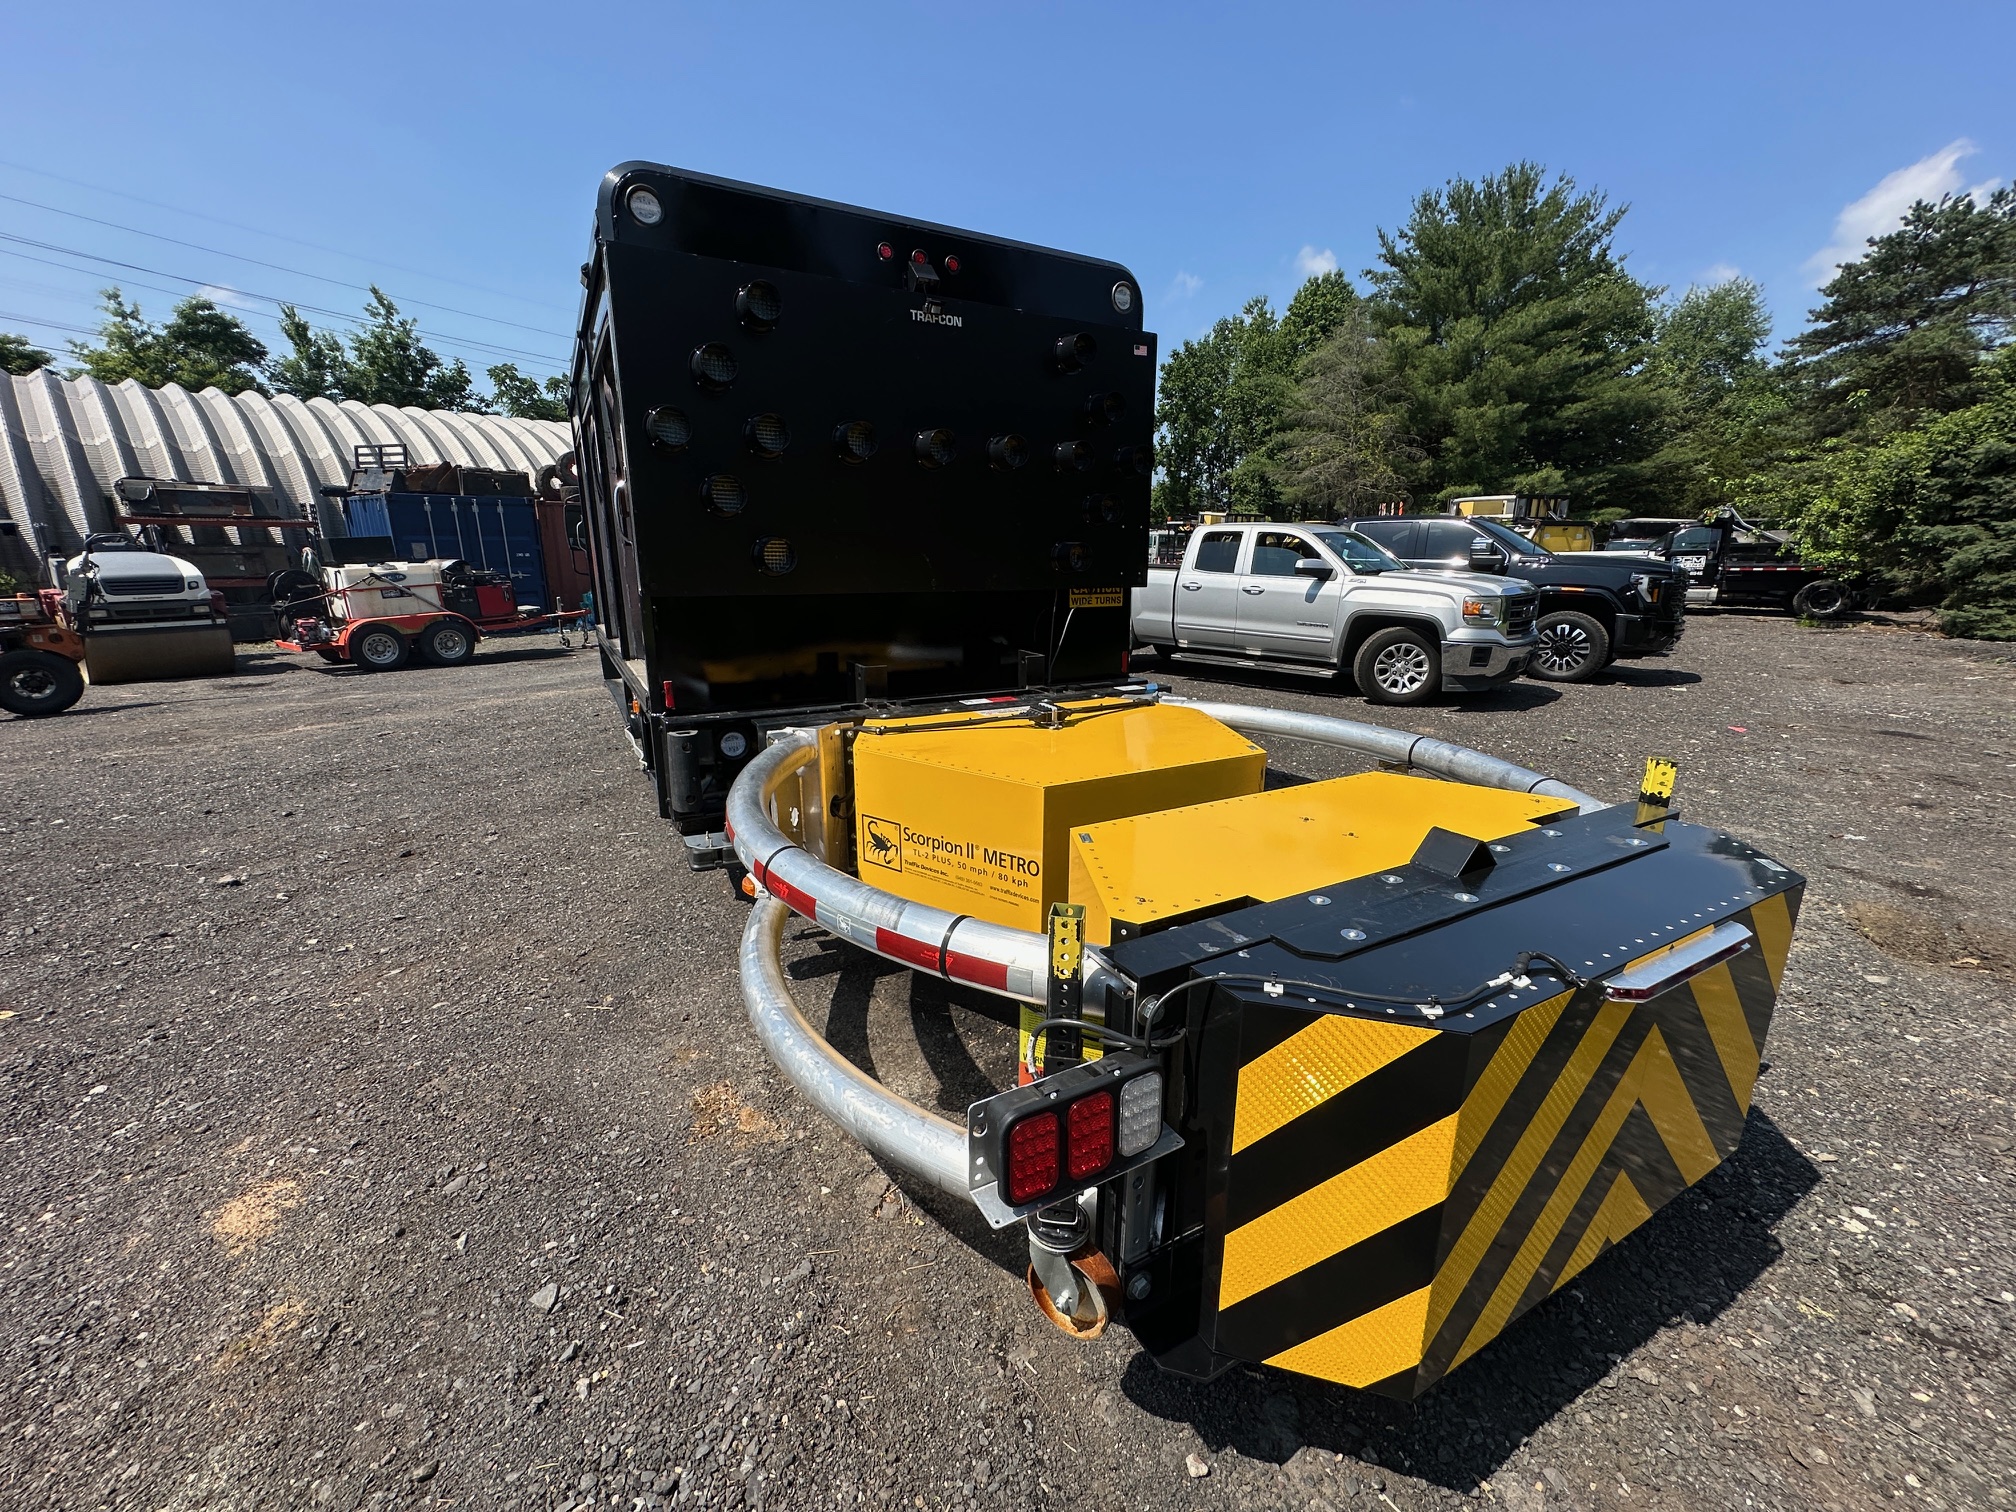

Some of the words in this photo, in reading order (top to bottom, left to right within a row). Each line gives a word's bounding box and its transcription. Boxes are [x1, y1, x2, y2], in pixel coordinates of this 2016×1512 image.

[910, 309, 962, 327] TRAFCON
[1071, 597, 1093, 606] WIDE
[1095, 596, 1122, 605] TURNS
[903, 826, 963, 856] Scorpion
[983, 847, 1040, 877] METRO
[912, 848, 930, 860] TL-2
[931, 853, 955, 868] PLUS,
[957, 860, 967, 870] 50
[969, 865, 988, 877] mph
[997, 872, 1009, 882] 80
[1011, 875, 1029, 888] kph
[920, 864, 940, 875] Devices
